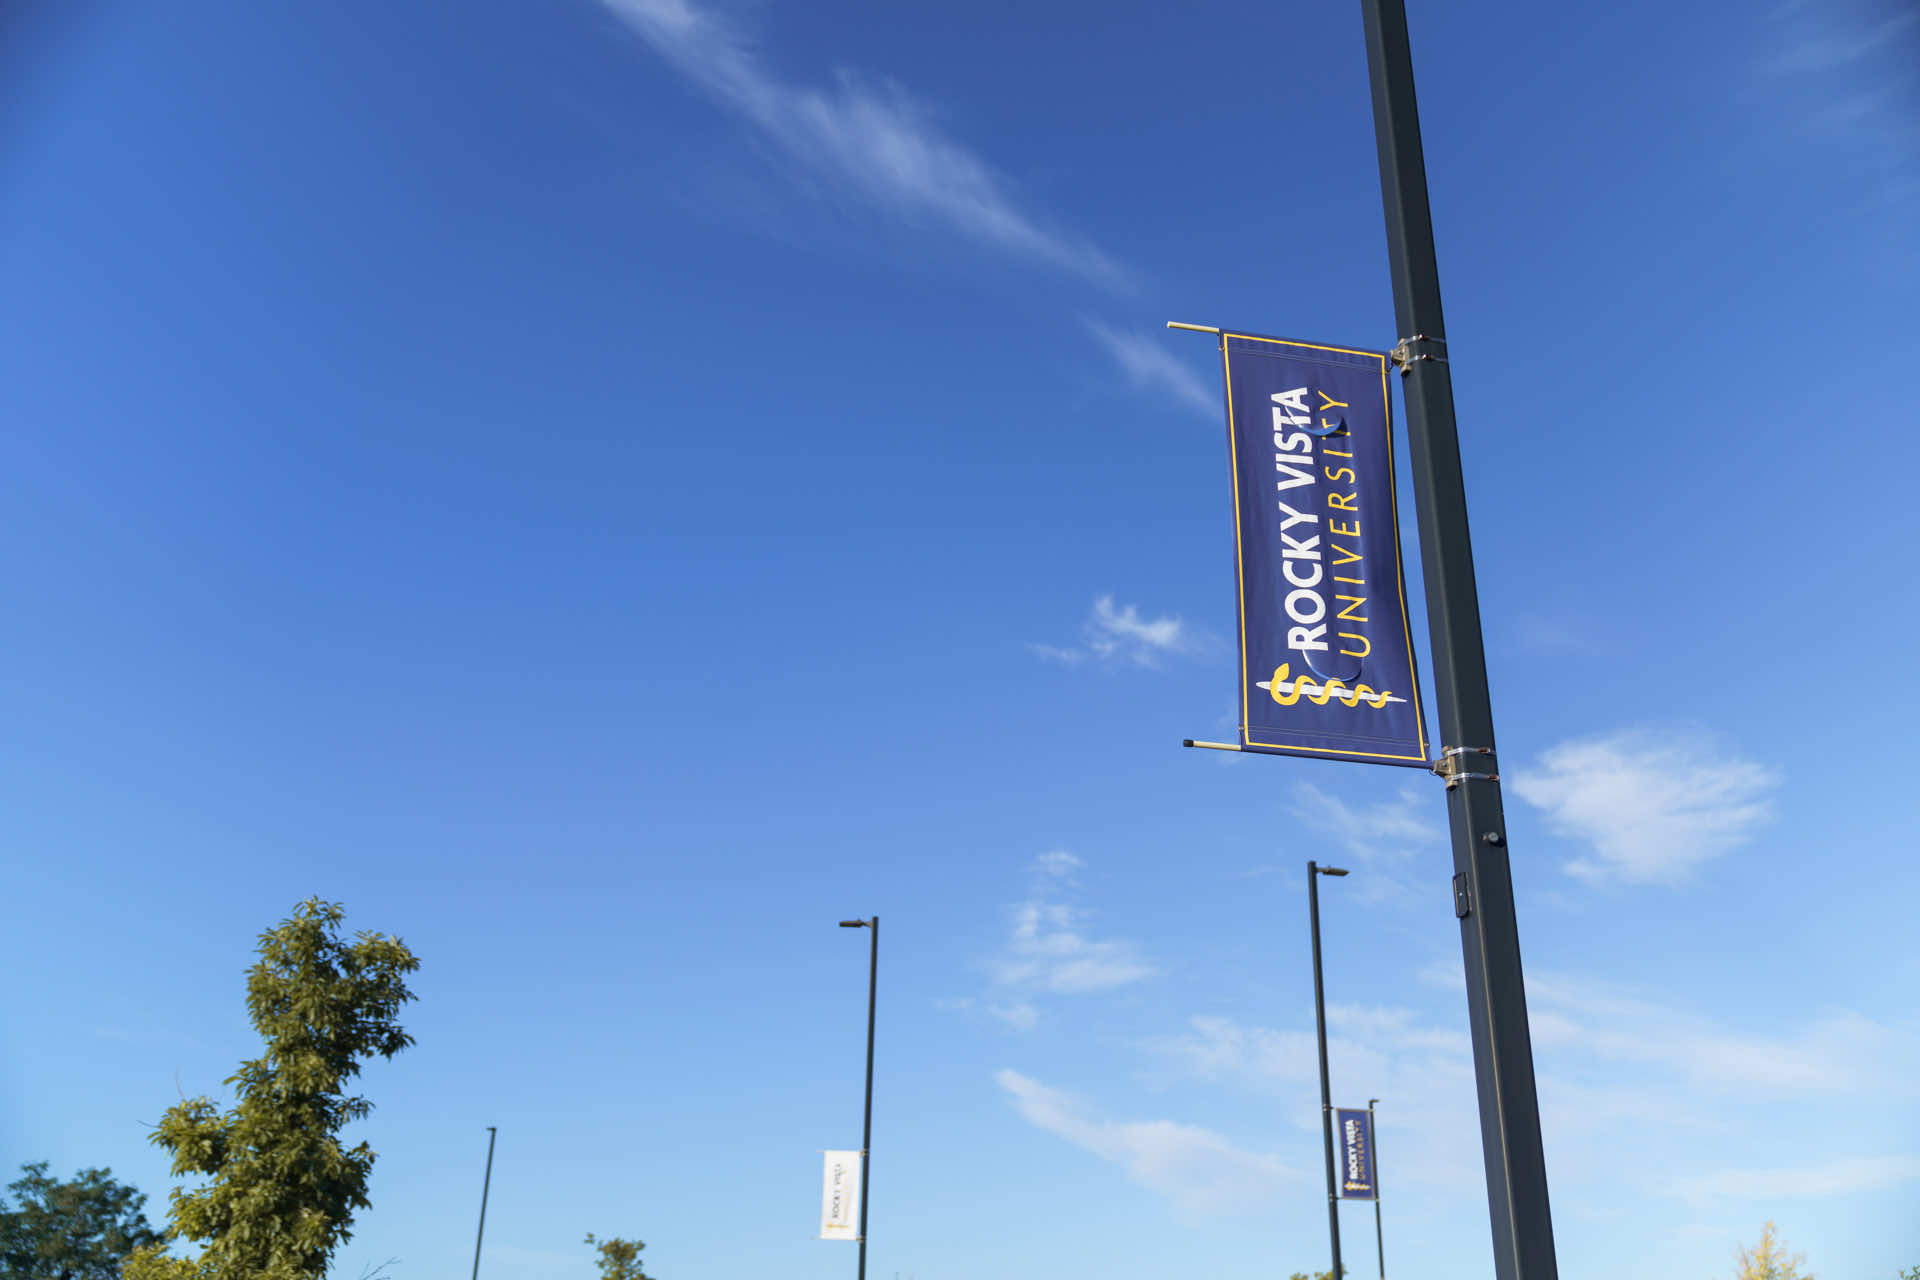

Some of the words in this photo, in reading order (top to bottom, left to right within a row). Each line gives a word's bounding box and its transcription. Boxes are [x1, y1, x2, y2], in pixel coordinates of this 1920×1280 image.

[1270, 387, 1316, 491] VISTA
[1278, 501, 1328, 651] ROCKY
[1318, 390, 1371, 658] UNIVERSITY
[1345, 1119, 1356, 1145] VISTA
[1348, 1147, 1358, 1180] ROCKY
